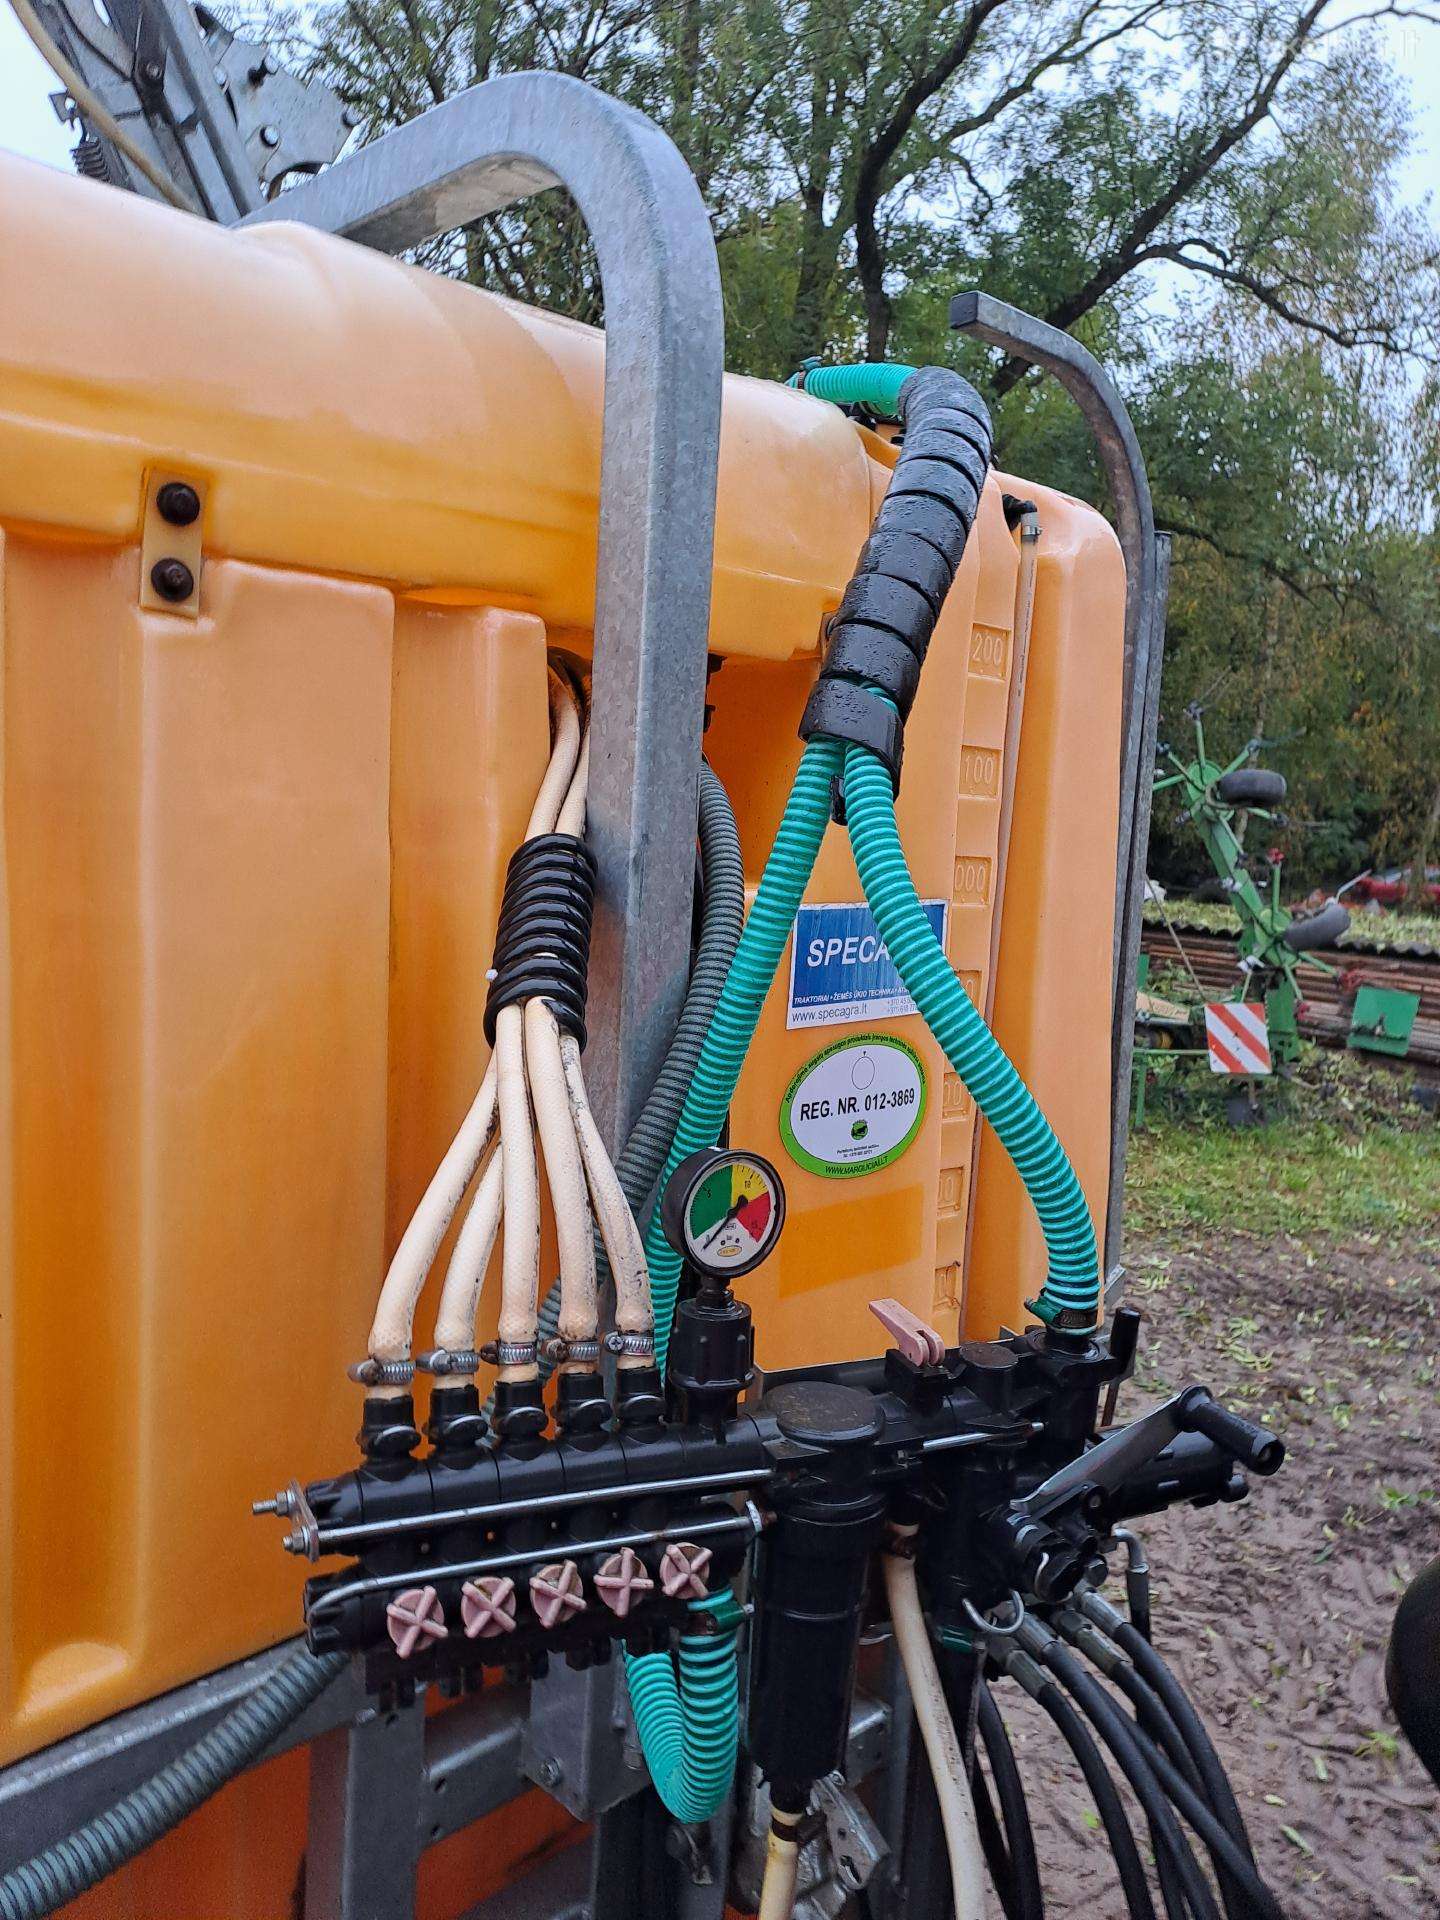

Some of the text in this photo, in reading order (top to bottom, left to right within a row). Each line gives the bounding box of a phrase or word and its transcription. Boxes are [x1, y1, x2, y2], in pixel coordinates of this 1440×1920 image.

[792, 1003, 868, 1023] www.specagra.lt
[800, 1087, 915, 1122] REG. NR. 012-3869
